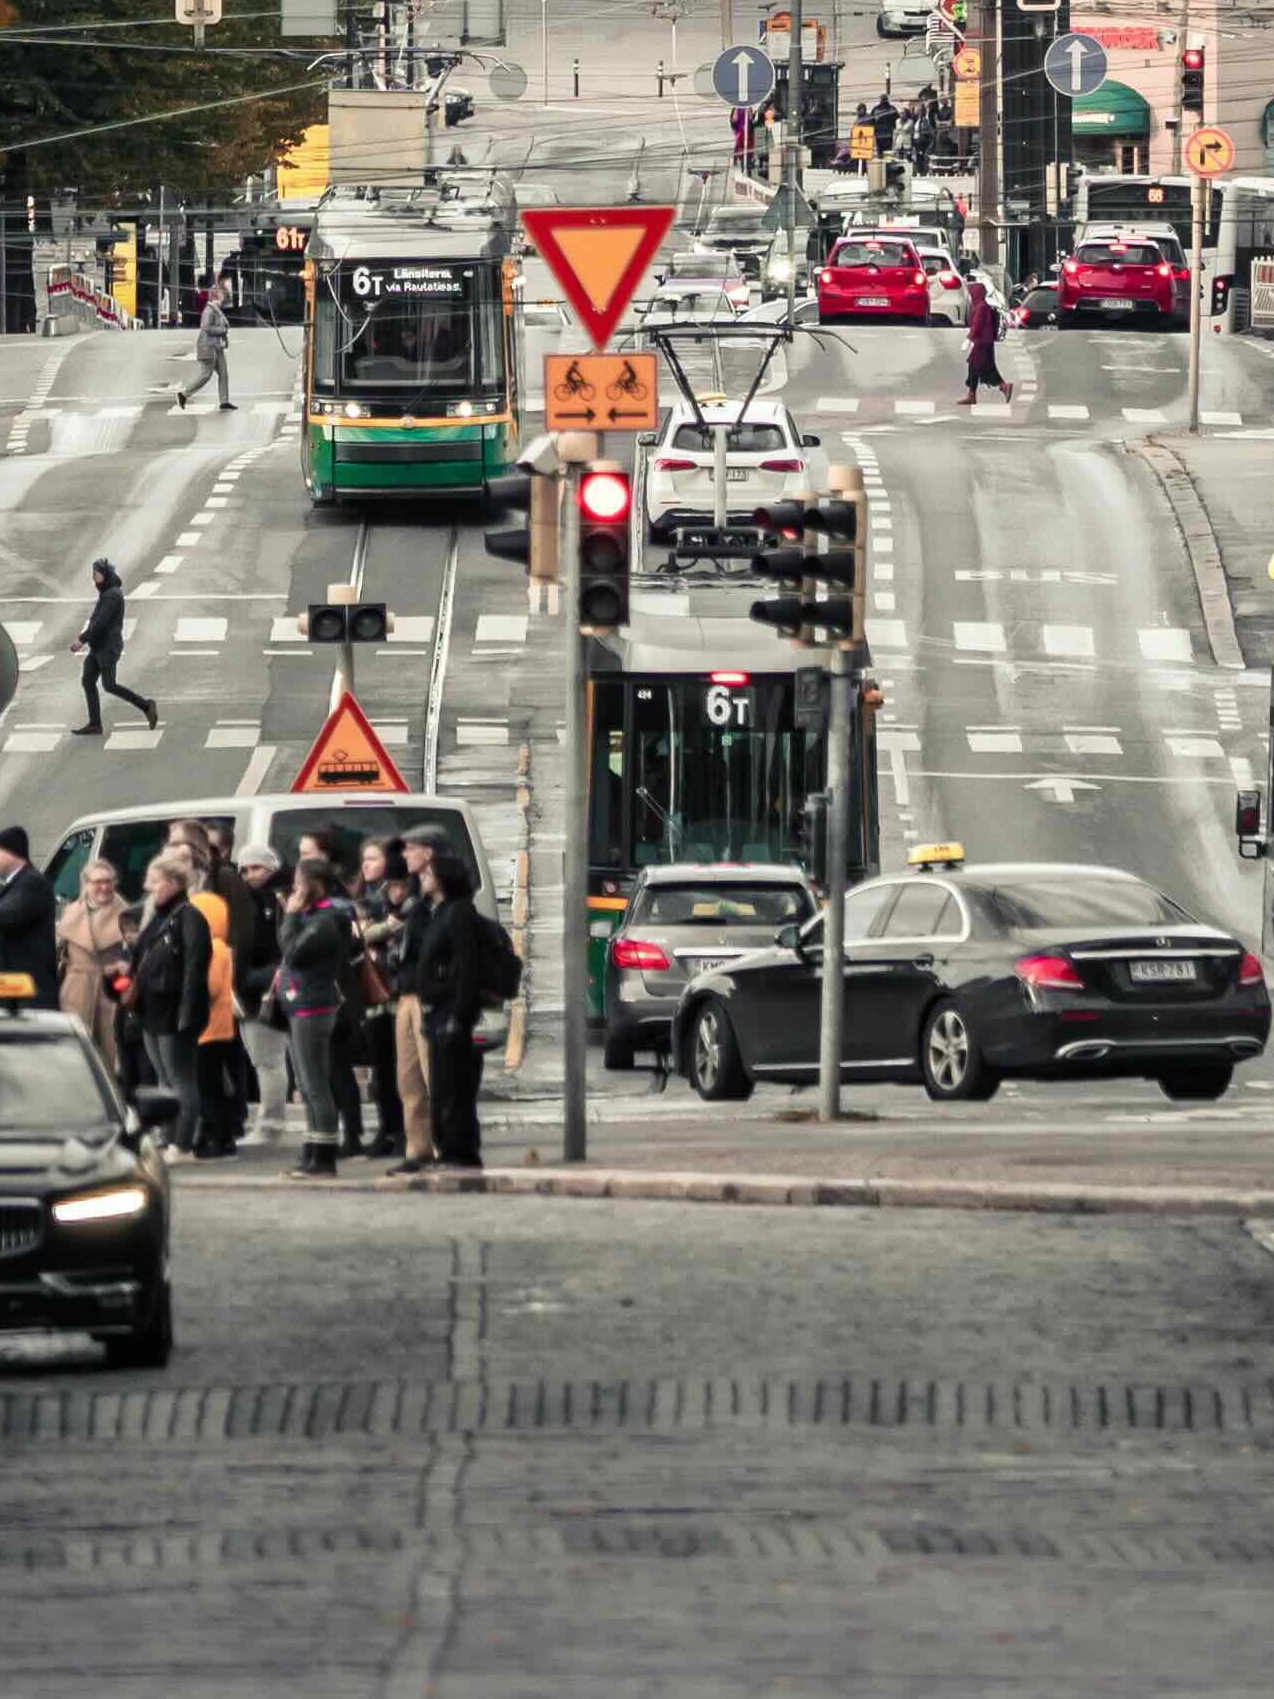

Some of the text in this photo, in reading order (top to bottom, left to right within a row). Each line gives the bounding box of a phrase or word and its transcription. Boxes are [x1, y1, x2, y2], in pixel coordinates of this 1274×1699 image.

[352, 266, 384, 296] 6T
[385, 282, 402, 292] via
[706, 685, 750, 725] 6T
